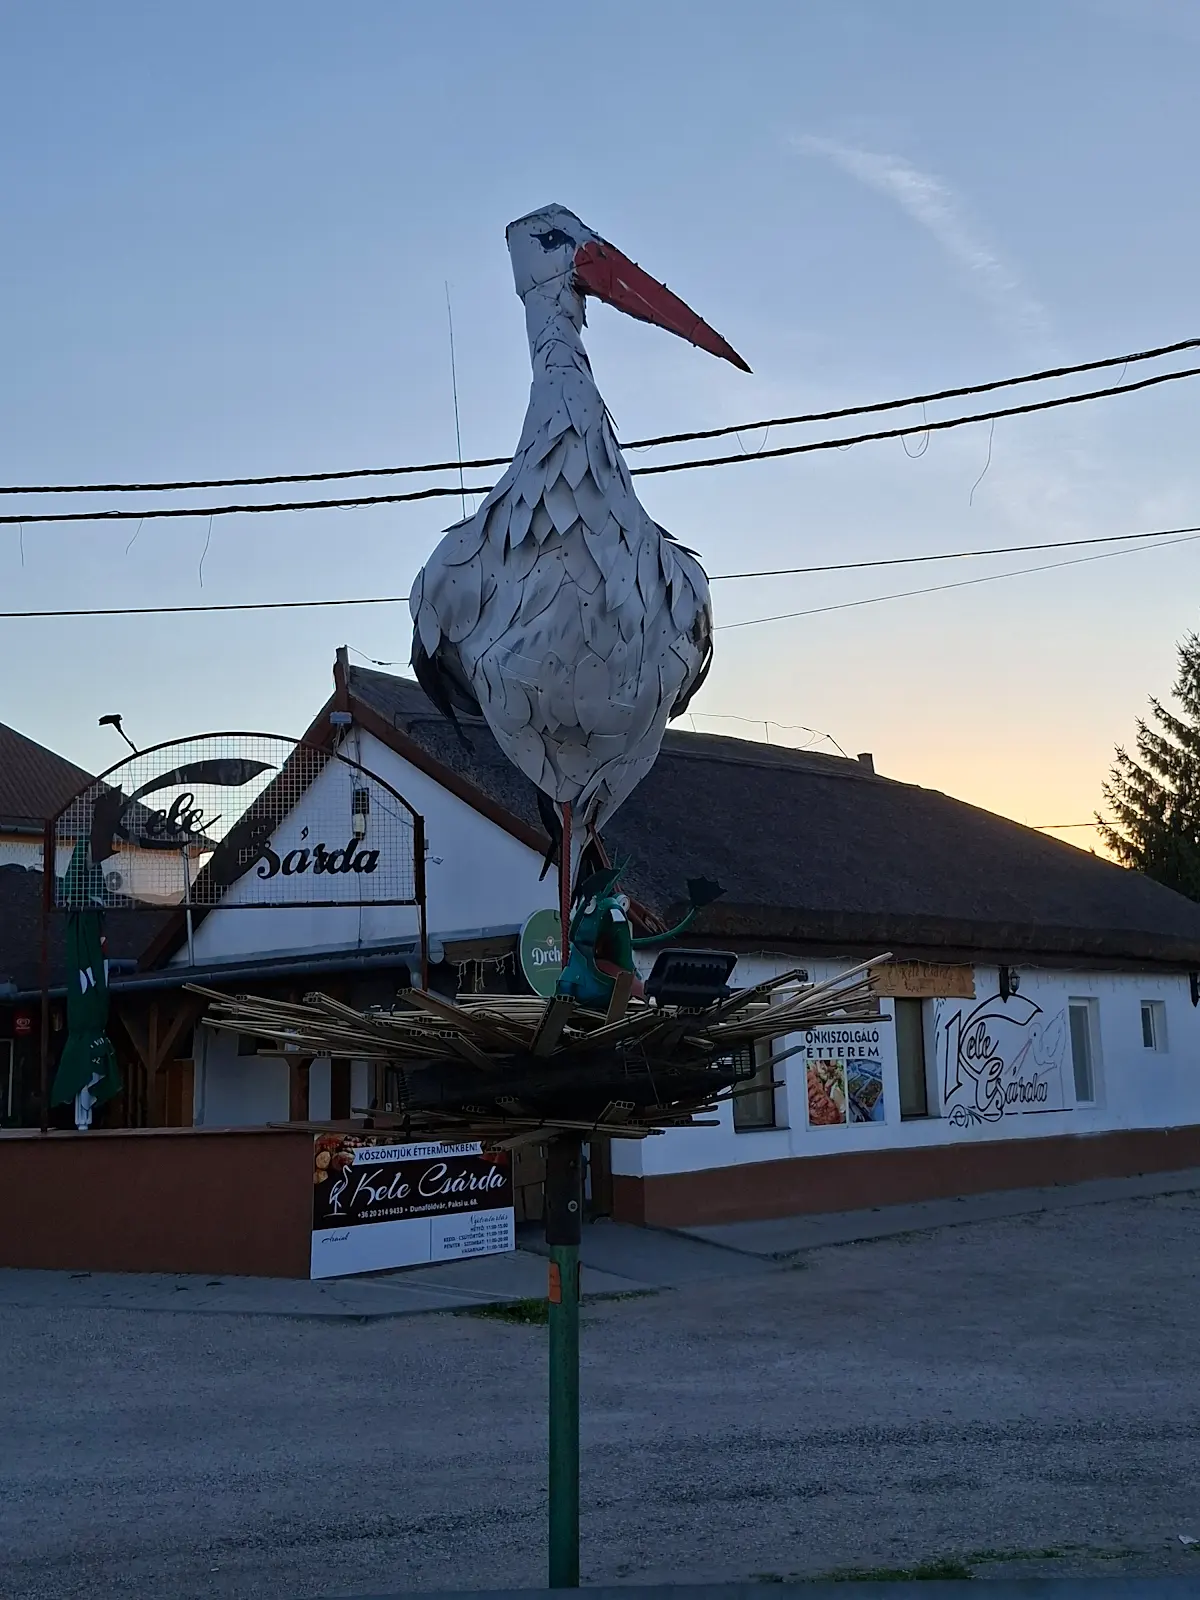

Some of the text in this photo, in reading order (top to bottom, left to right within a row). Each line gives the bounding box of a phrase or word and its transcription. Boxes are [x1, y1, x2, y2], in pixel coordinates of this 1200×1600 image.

[89, 758, 278, 864] Kele
[532, 945, 561, 966] Dreh
[806, 1044, 880, 1059] ÉTTEREM
[944, 992, 1043, 1105] Kele
[358, 1147, 412, 1161] KÖSZÖNTJÜK
[349, 1162, 508, 1208] Kele Csárda
[369, 1209, 377, 1217] 20
